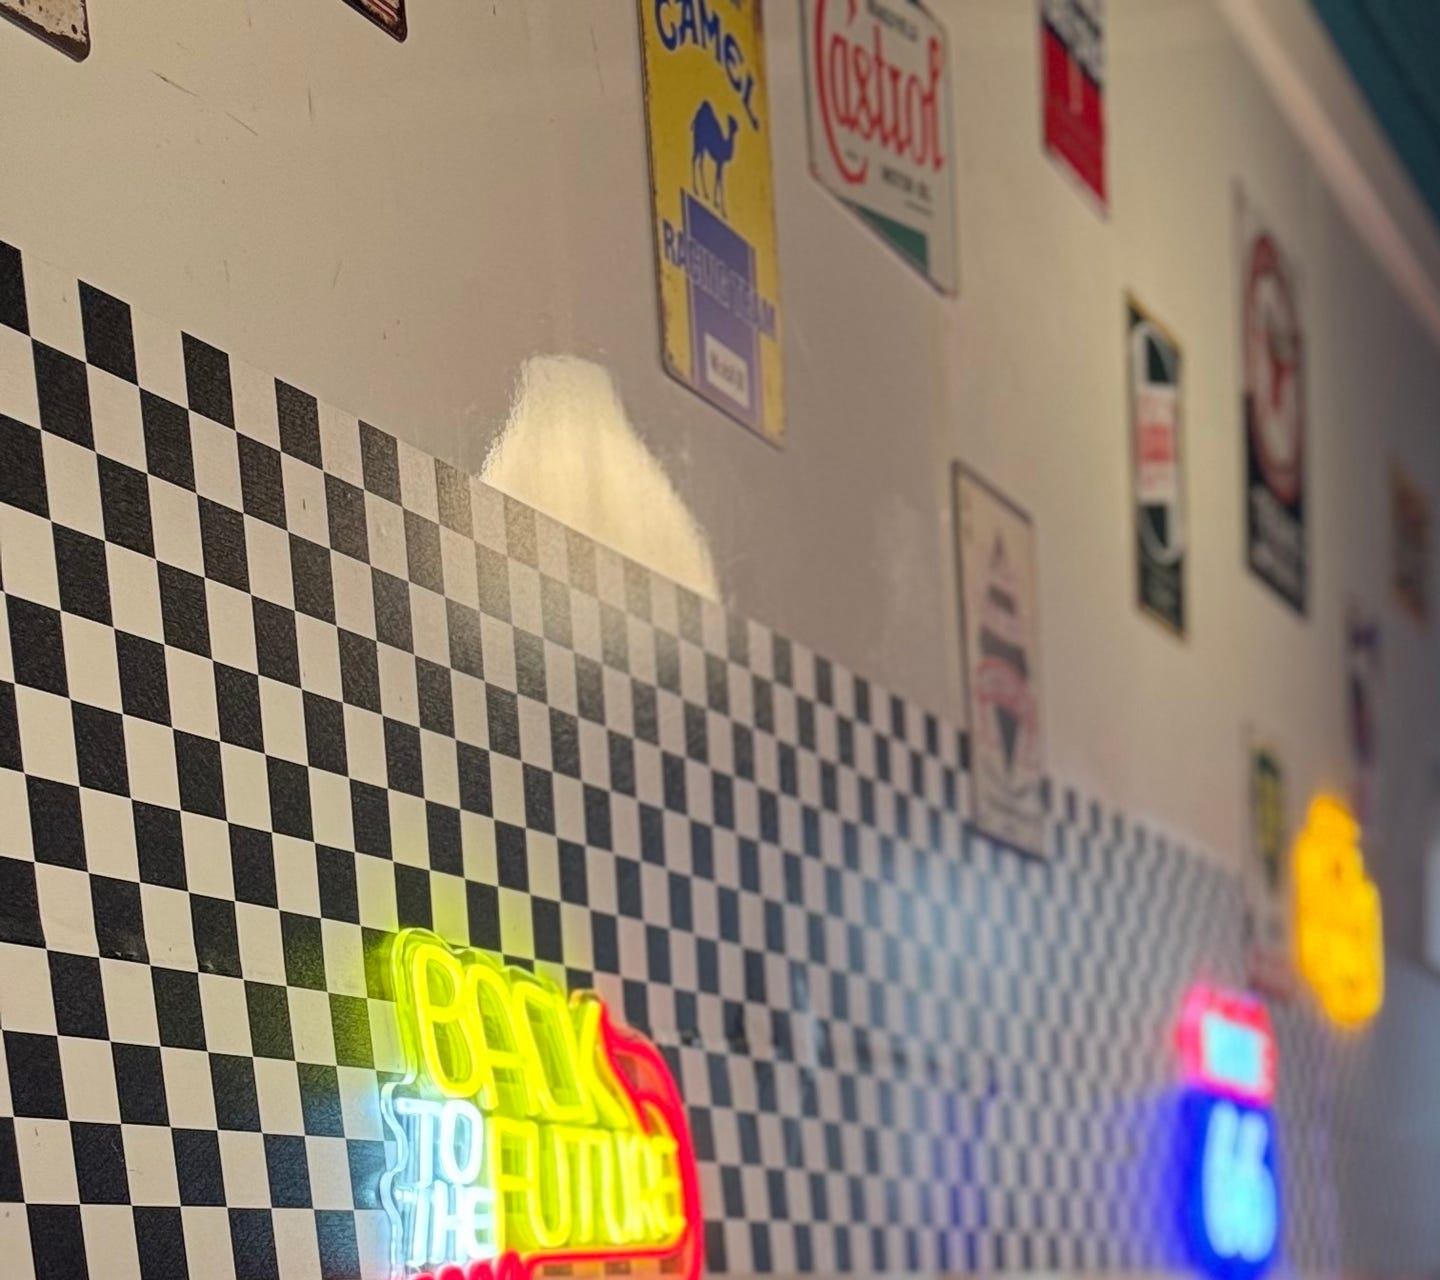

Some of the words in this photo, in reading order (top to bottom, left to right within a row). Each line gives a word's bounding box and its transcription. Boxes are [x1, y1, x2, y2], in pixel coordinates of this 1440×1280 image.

[655, 0, 759, 131] CAMEL
[814, 0, 945, 184] Castrol
[411, 942, 631, 1130] BACK
[395, 1098, 485, 1188] TO
[486, 1116, 686, 1249] FUTURE
[395, 1186, 499, 1268] THE
